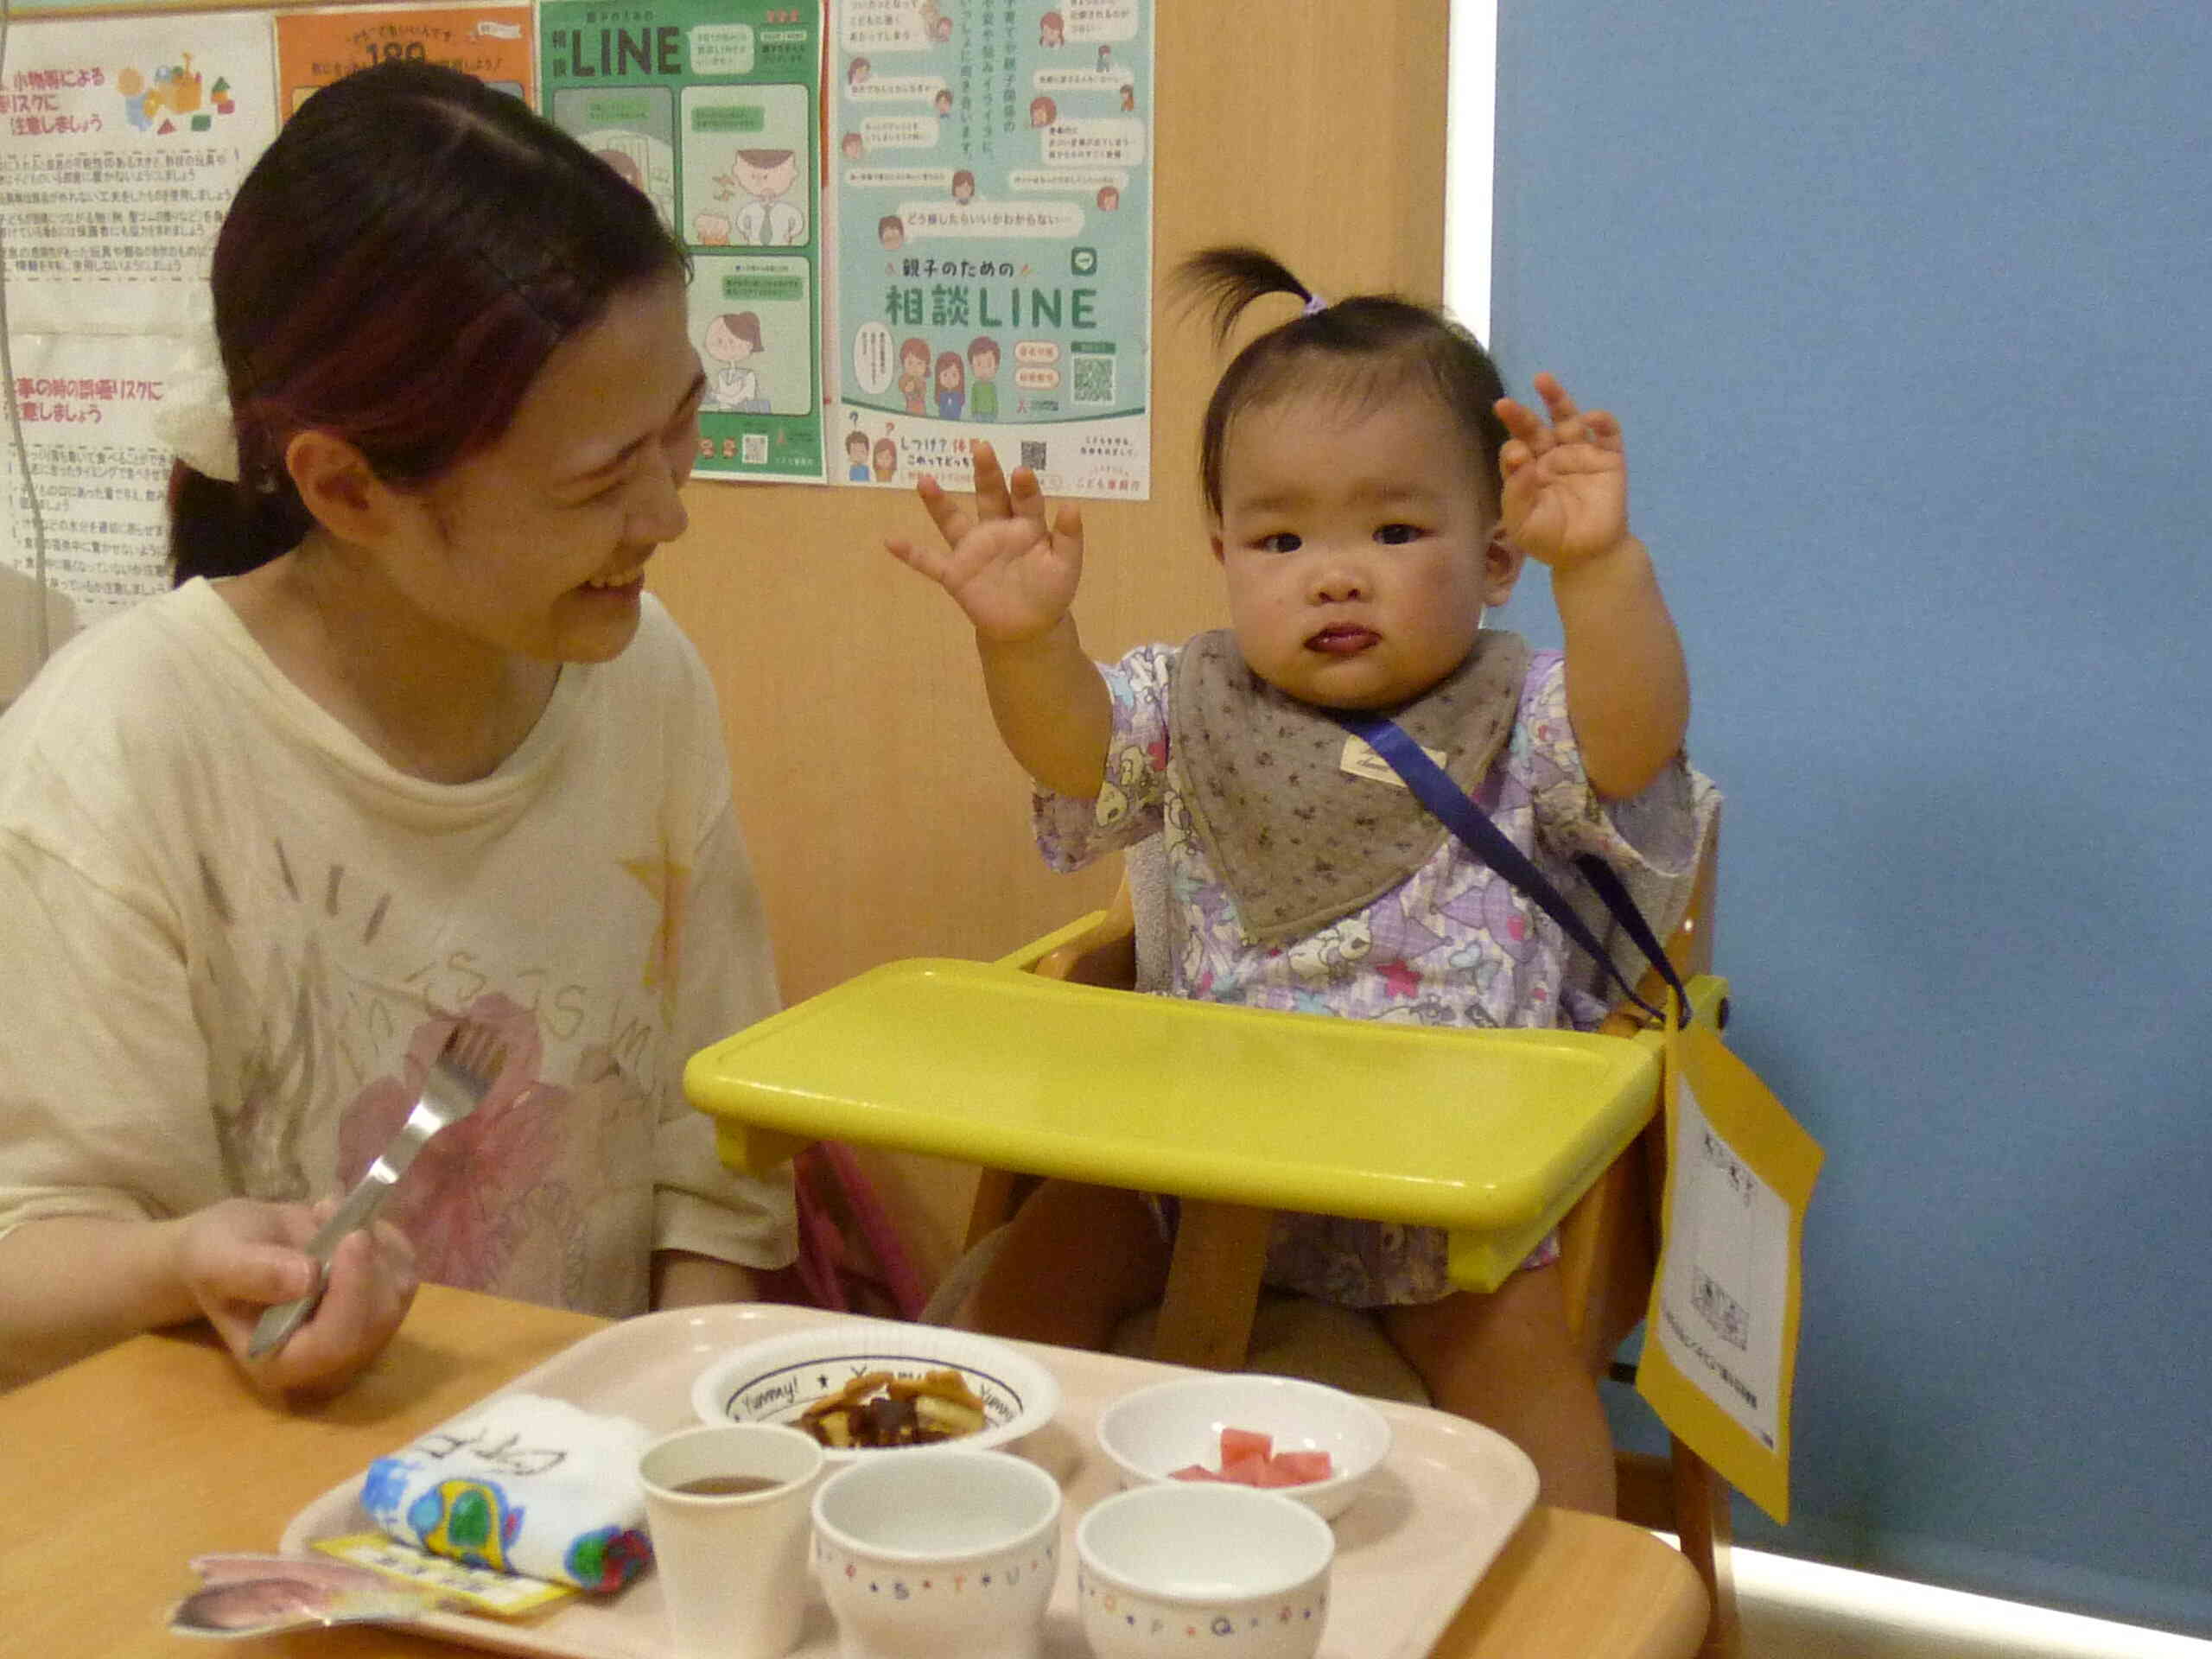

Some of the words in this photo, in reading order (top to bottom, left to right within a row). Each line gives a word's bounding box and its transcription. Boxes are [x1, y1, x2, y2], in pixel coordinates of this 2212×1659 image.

[571, 26, 682, 77] LINE
[903, 257, 1014, 278] 親子のための
[885, 283, 1097, 330] 相談LINE
[741, 1376, 798, 1413] Yummy!
